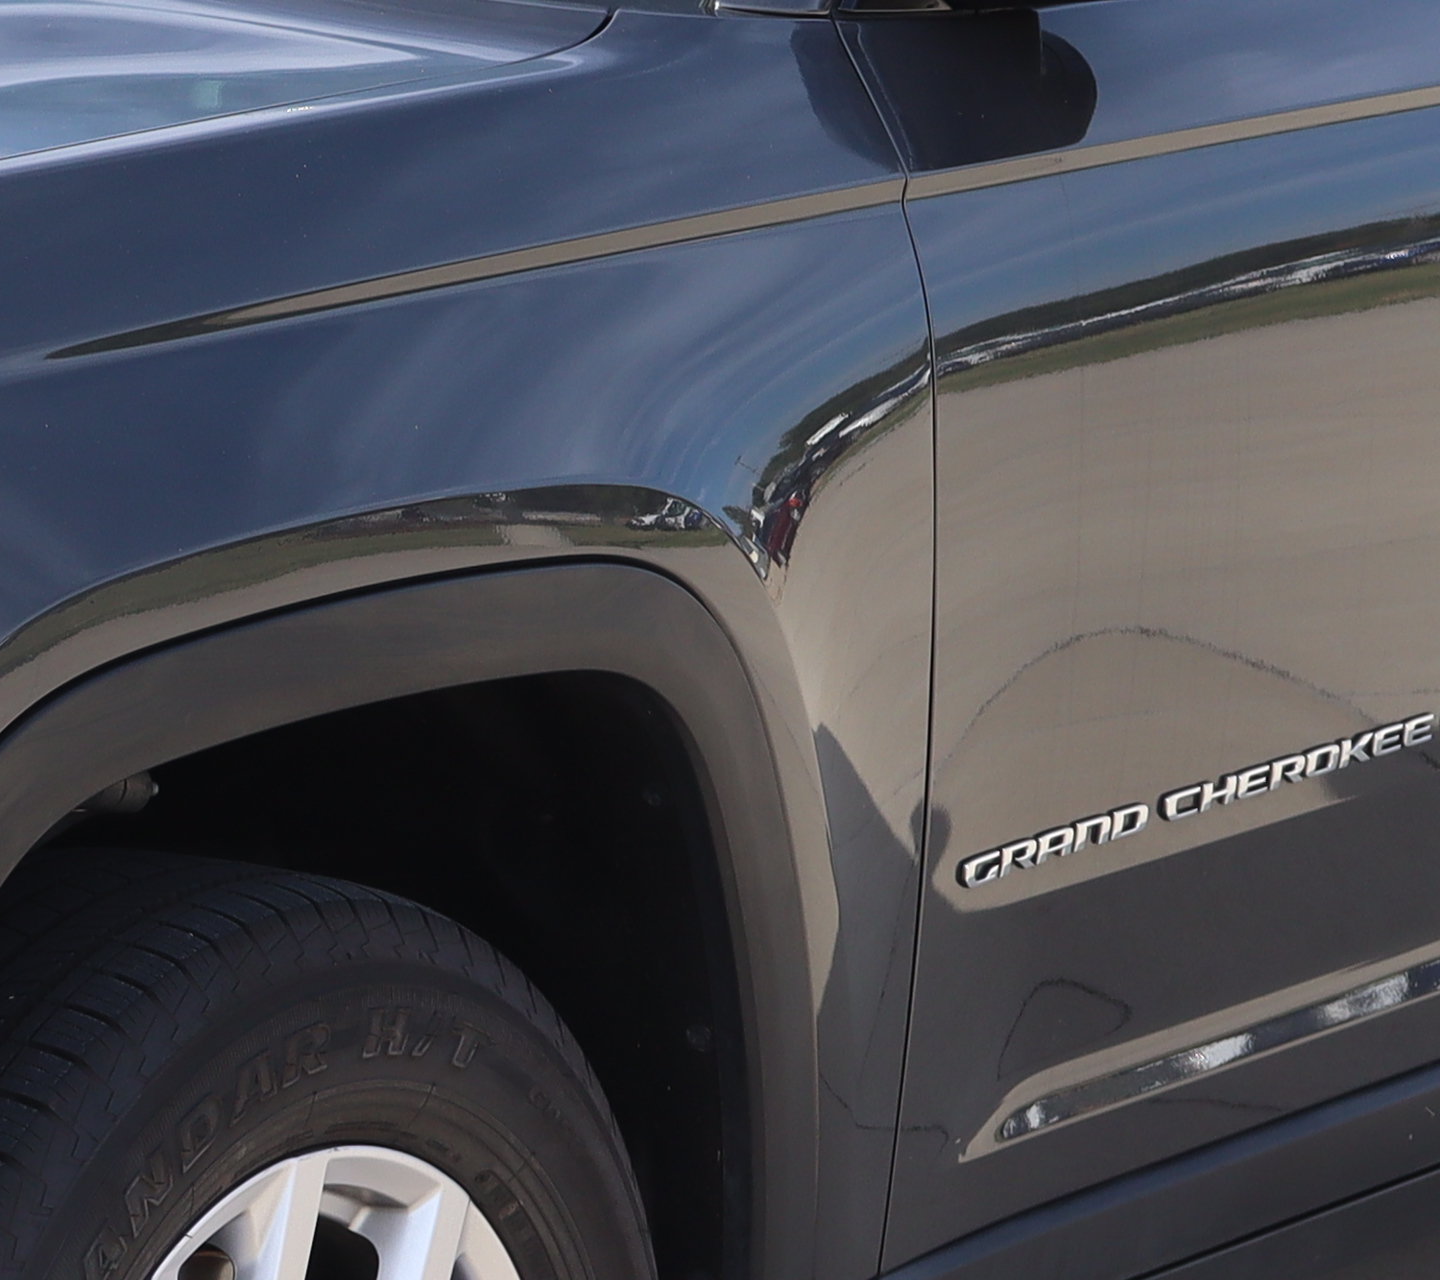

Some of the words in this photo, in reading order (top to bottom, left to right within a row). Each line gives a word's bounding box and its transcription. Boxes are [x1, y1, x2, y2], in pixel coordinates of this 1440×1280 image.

[958, 802, 1149, 889] GRAND
[1159, 713, 1435, 822] CHEROKEE
[360, 1005, 497, 1074] H/T
